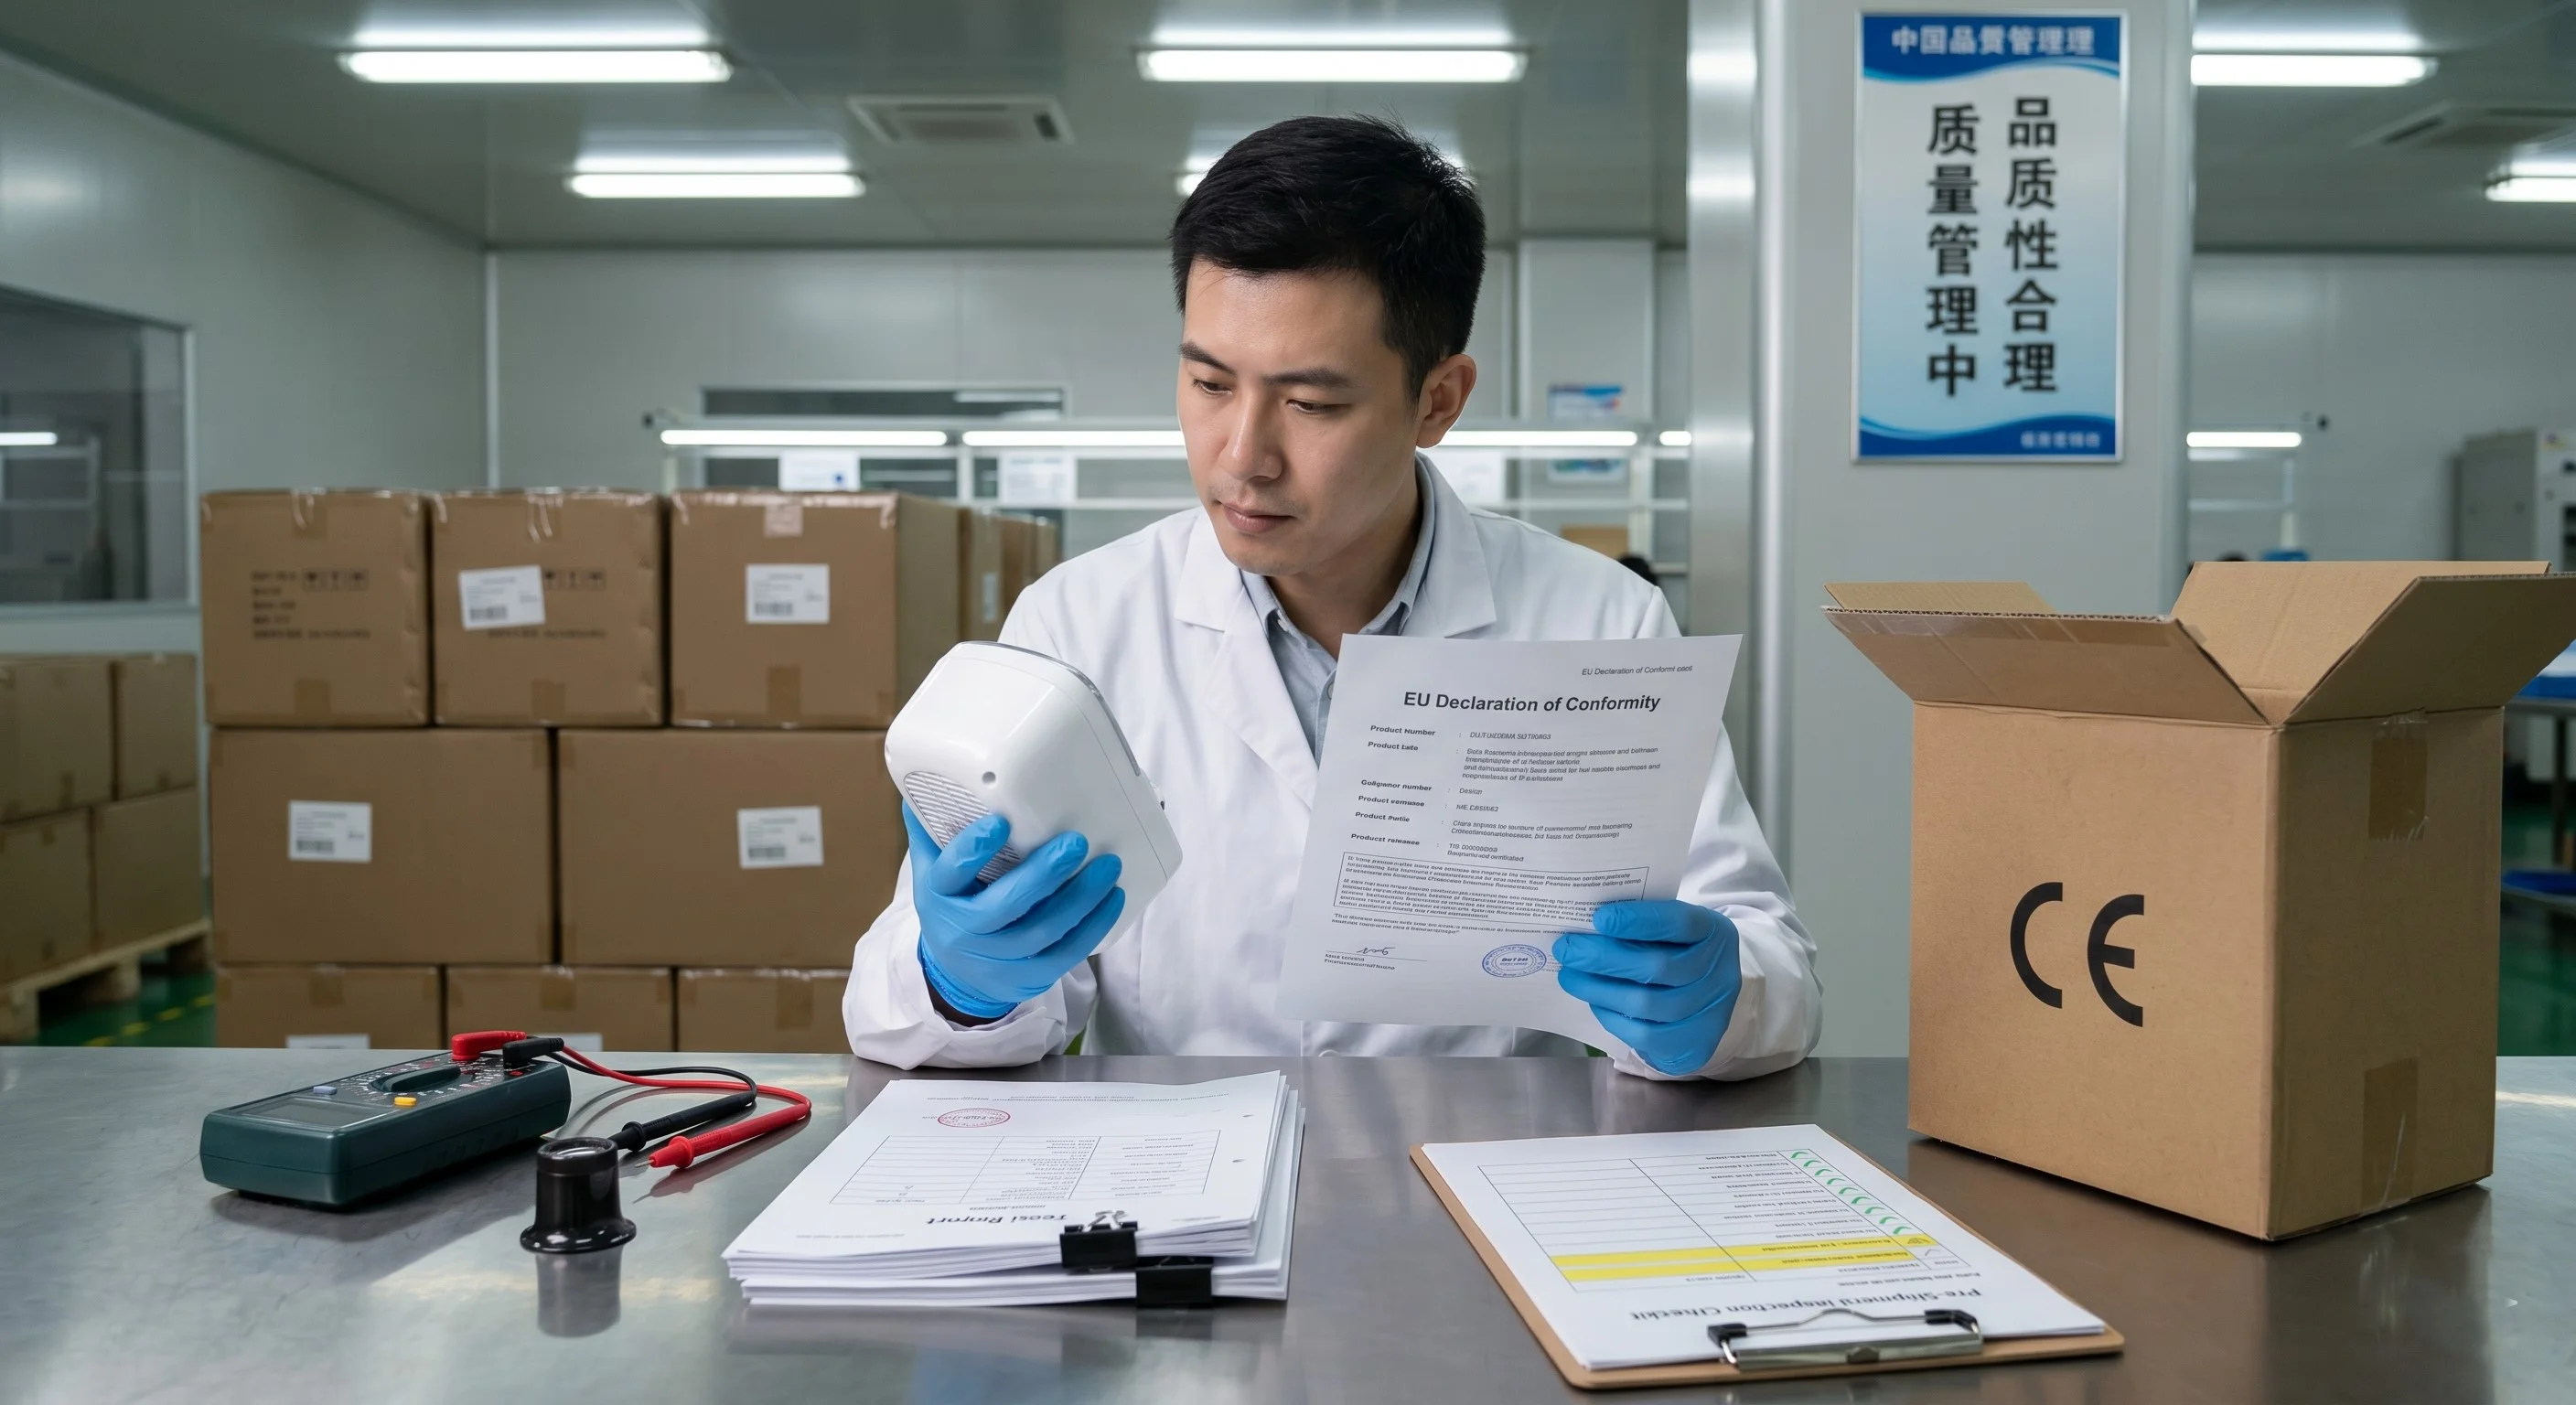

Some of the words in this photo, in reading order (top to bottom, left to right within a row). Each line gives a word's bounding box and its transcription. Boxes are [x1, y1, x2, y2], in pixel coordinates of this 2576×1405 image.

[1927, 104, 1980, 397] 质量管理中
[2005, 97, 2058, 392] 品质性合理
[1403, 692, 1430, 708] EU
[1435, 694, 1538, 711] Declaration
[1543, 695, 1562, 712] of
[1566, 695, 1660, 713] Conformity
[1370, 724, 1402, 733] Product
[1368, 741, 1400, 749] Product
[1358, 794, 1389, 803] Product
[1356, 811, 1386, 820] Product
[2010, 882, 2144, 1027] CE
